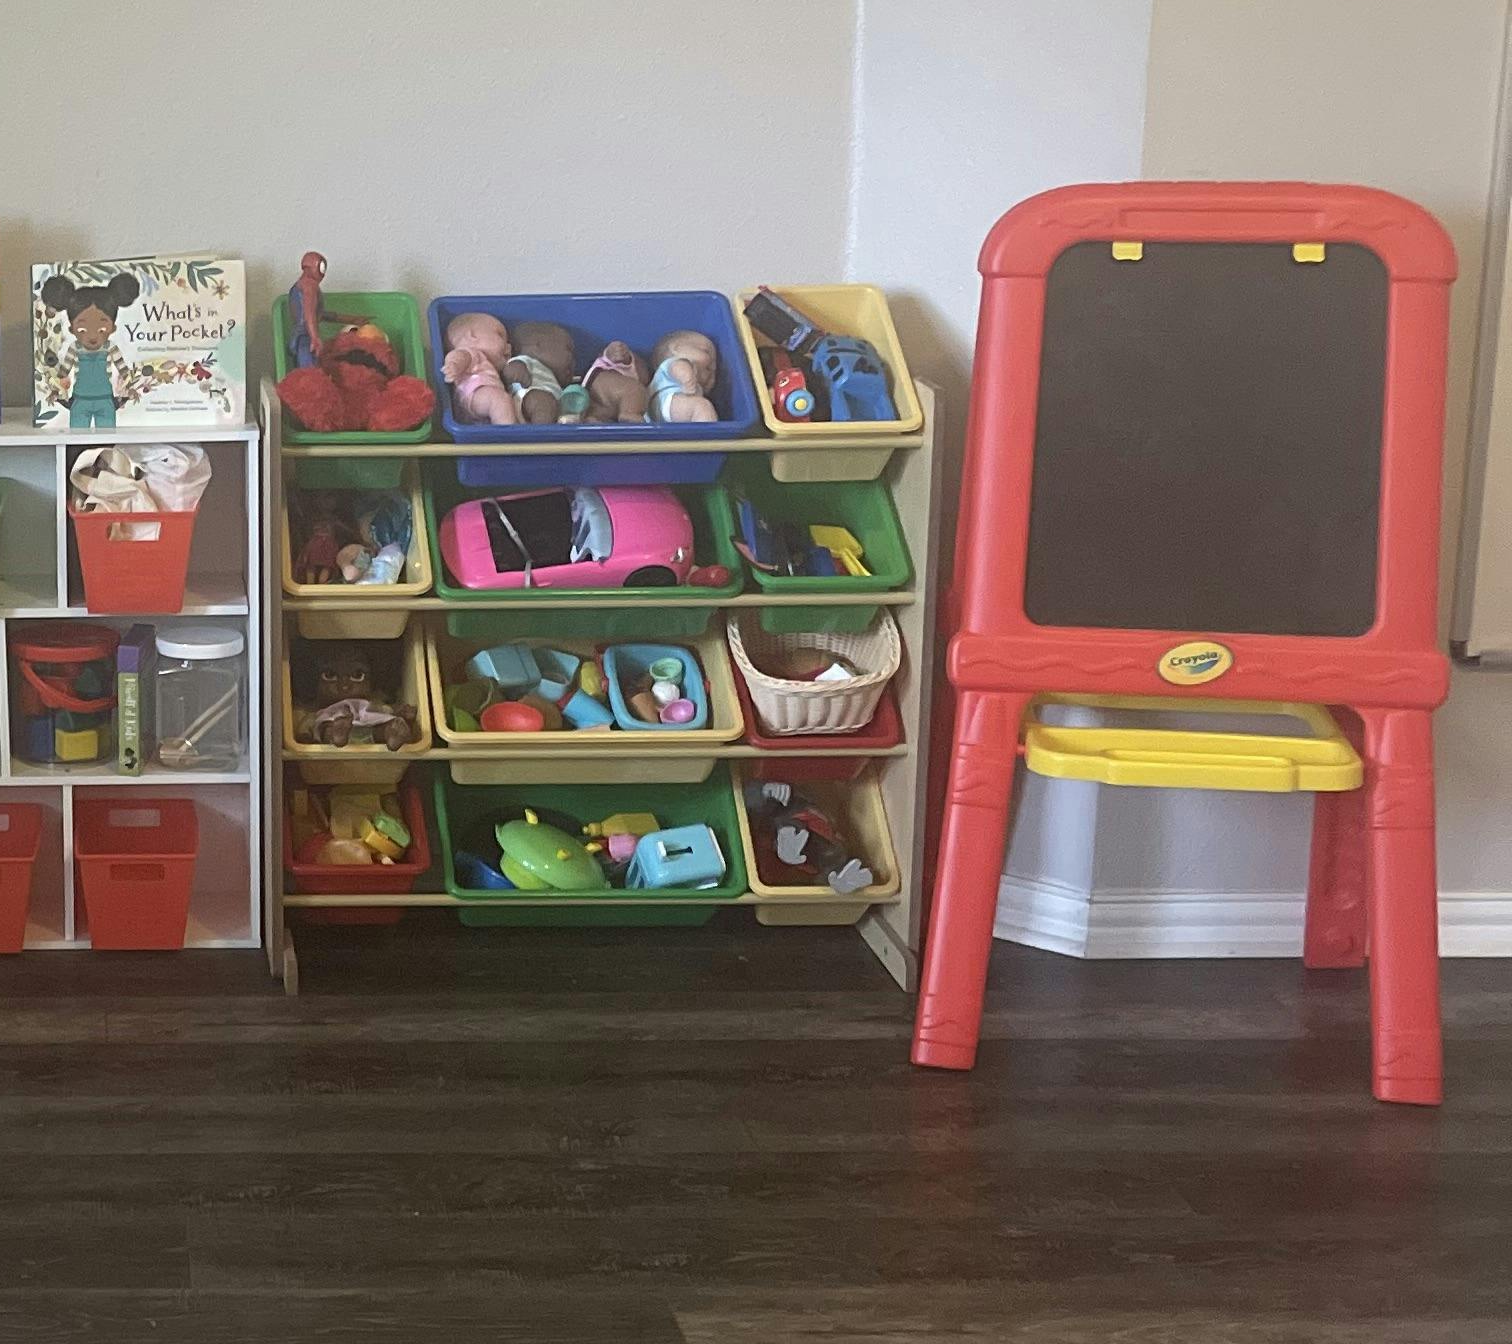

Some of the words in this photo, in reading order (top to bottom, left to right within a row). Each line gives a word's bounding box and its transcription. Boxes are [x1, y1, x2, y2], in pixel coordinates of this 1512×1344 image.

[142, 301, 202, 322] What's
[124, 322, 168, 343] Your
[170, 318, 236, 342] Pocket?
[1170, 651, 1219, 666] Crayola
